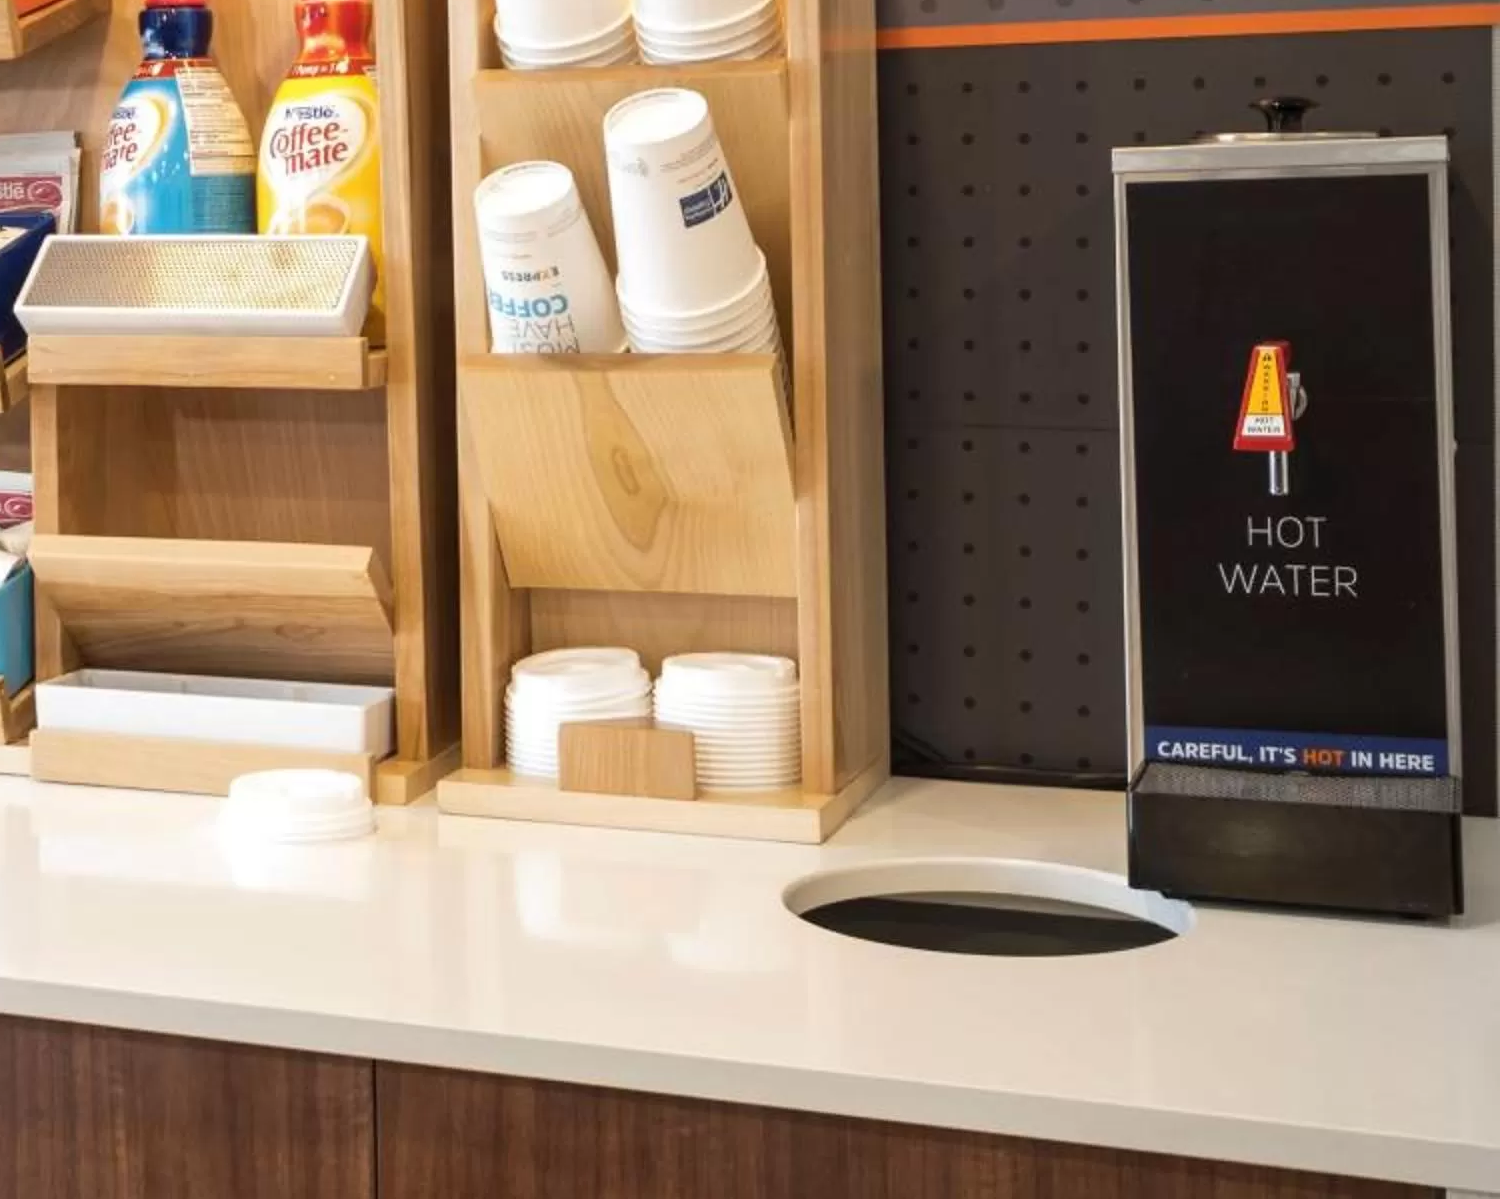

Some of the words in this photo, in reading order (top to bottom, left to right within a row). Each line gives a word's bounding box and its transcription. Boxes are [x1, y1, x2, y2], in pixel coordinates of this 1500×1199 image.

[284, 141, 349, 177] mate
[1246, 515, 1327, 549] HOT
[1218, 562, 1359, 598] WATER
[1156, 739, 1254, 764] CAREFUL,
[1259, 745, 1297, 764] IT'S
[1303, 748, 1345, 767] HOT
[1351, 750, 1373, 768] IN
[1379, 751, 1434, 772] HERE
